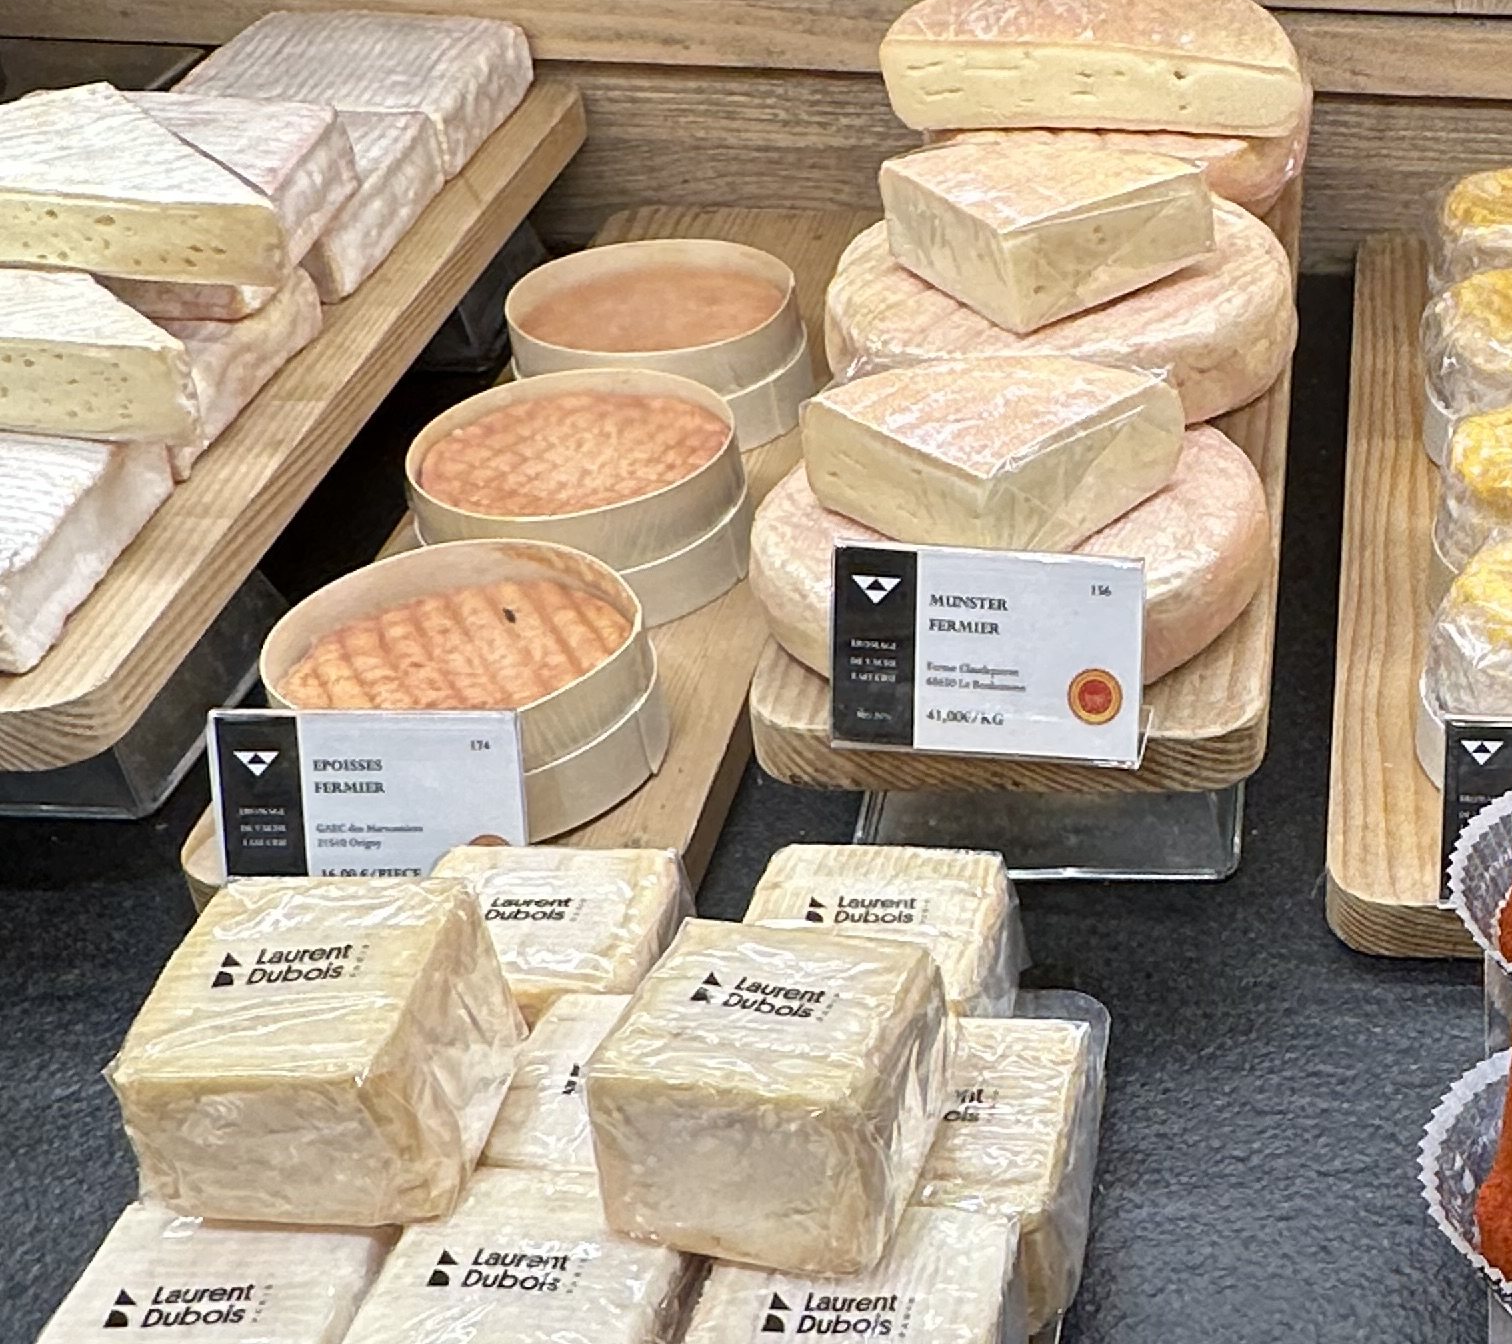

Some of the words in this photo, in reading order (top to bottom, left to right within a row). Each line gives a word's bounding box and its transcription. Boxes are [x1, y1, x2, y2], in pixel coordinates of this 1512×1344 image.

[929, 594, 1009, 612] MUNSTER
[928, 618, 1000, 635] FERMIER
[313, 758, 383, 772] EPOISSES
[314, 781, 386, 795] FERMIER
[490, 897, 574, 908] Laurent
[837, 895, 917, 909] Laurent
[484, 907, 565, 921] Dubois
[834, 909, 914, 924] Dubois
[255, 944, 353, 965] Laurent
[246, 961, 344, 985] Dubois
[734, 976, 825, 1004] Laurent
[722, 992, 814, 1018] Dubois
[472, 1248, 570, 1271] Laurent
[460, 1269, 562, 1292] Dubois
[151, 1283, 255, 1306] Laurent
[804, 1291, 897, 1313] Laurent
[140, 1304, 246, 1328] Dubois
[796, 1312, 892, 1336] Dubois
